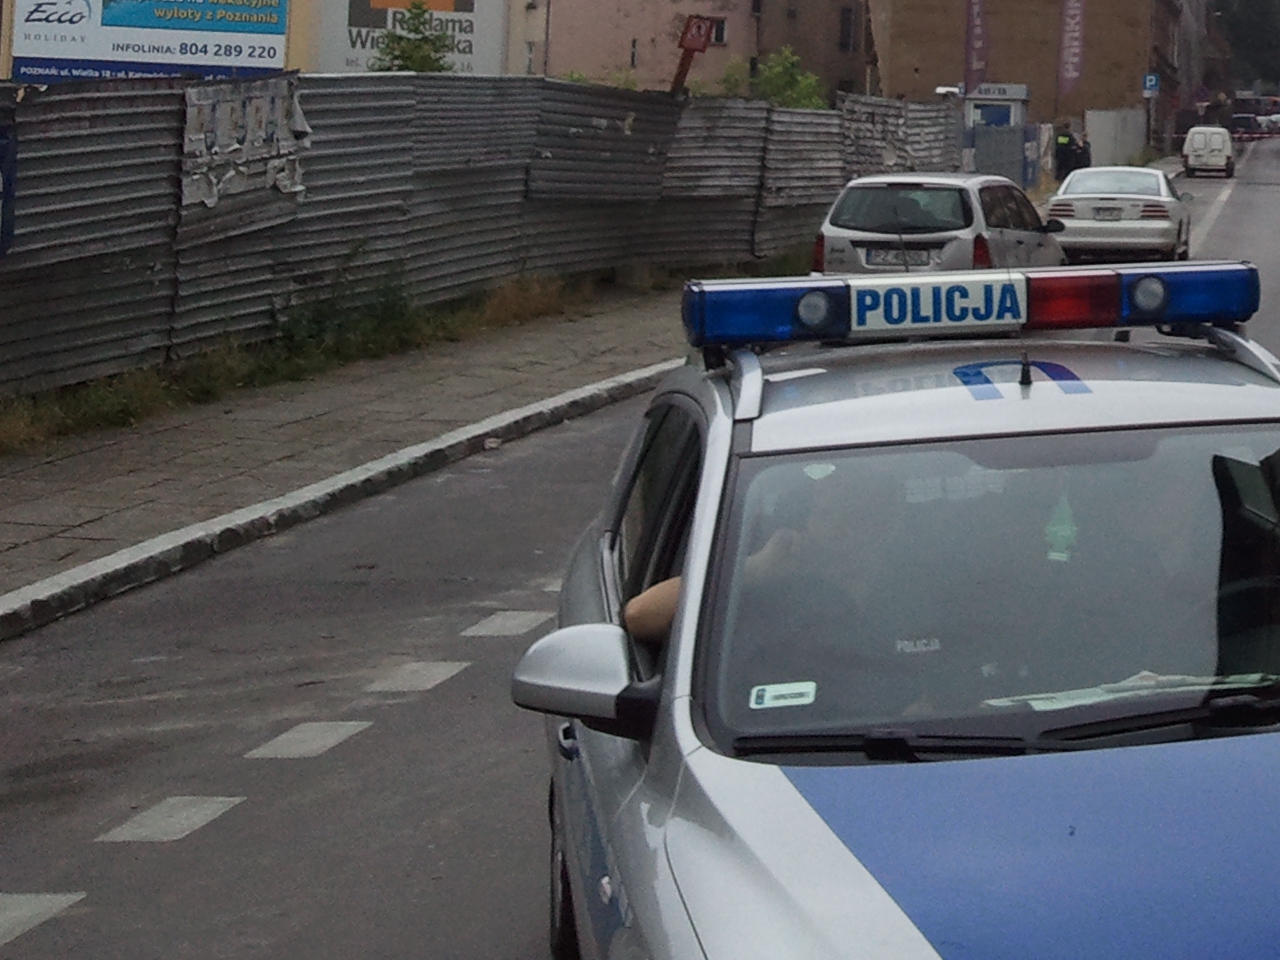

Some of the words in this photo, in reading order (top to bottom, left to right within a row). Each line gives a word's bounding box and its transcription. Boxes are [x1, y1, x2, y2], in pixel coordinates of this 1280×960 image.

[23, 2, 88, 25] Ecco
[205, 11, 213, 21] z
[216, 9, 279, 24] Poznania
[23, 33, 87, 44] HOLIDAY
[112, 43, 177, 55] INFOLINIA:
[179, 42, 209, 57] 804
[213, 43, 243, 58] 289
[247, 45, 277, 59] 220
[1145, 75, 1156, 88] P
[856, 282, 1021, 327] POLICJA
